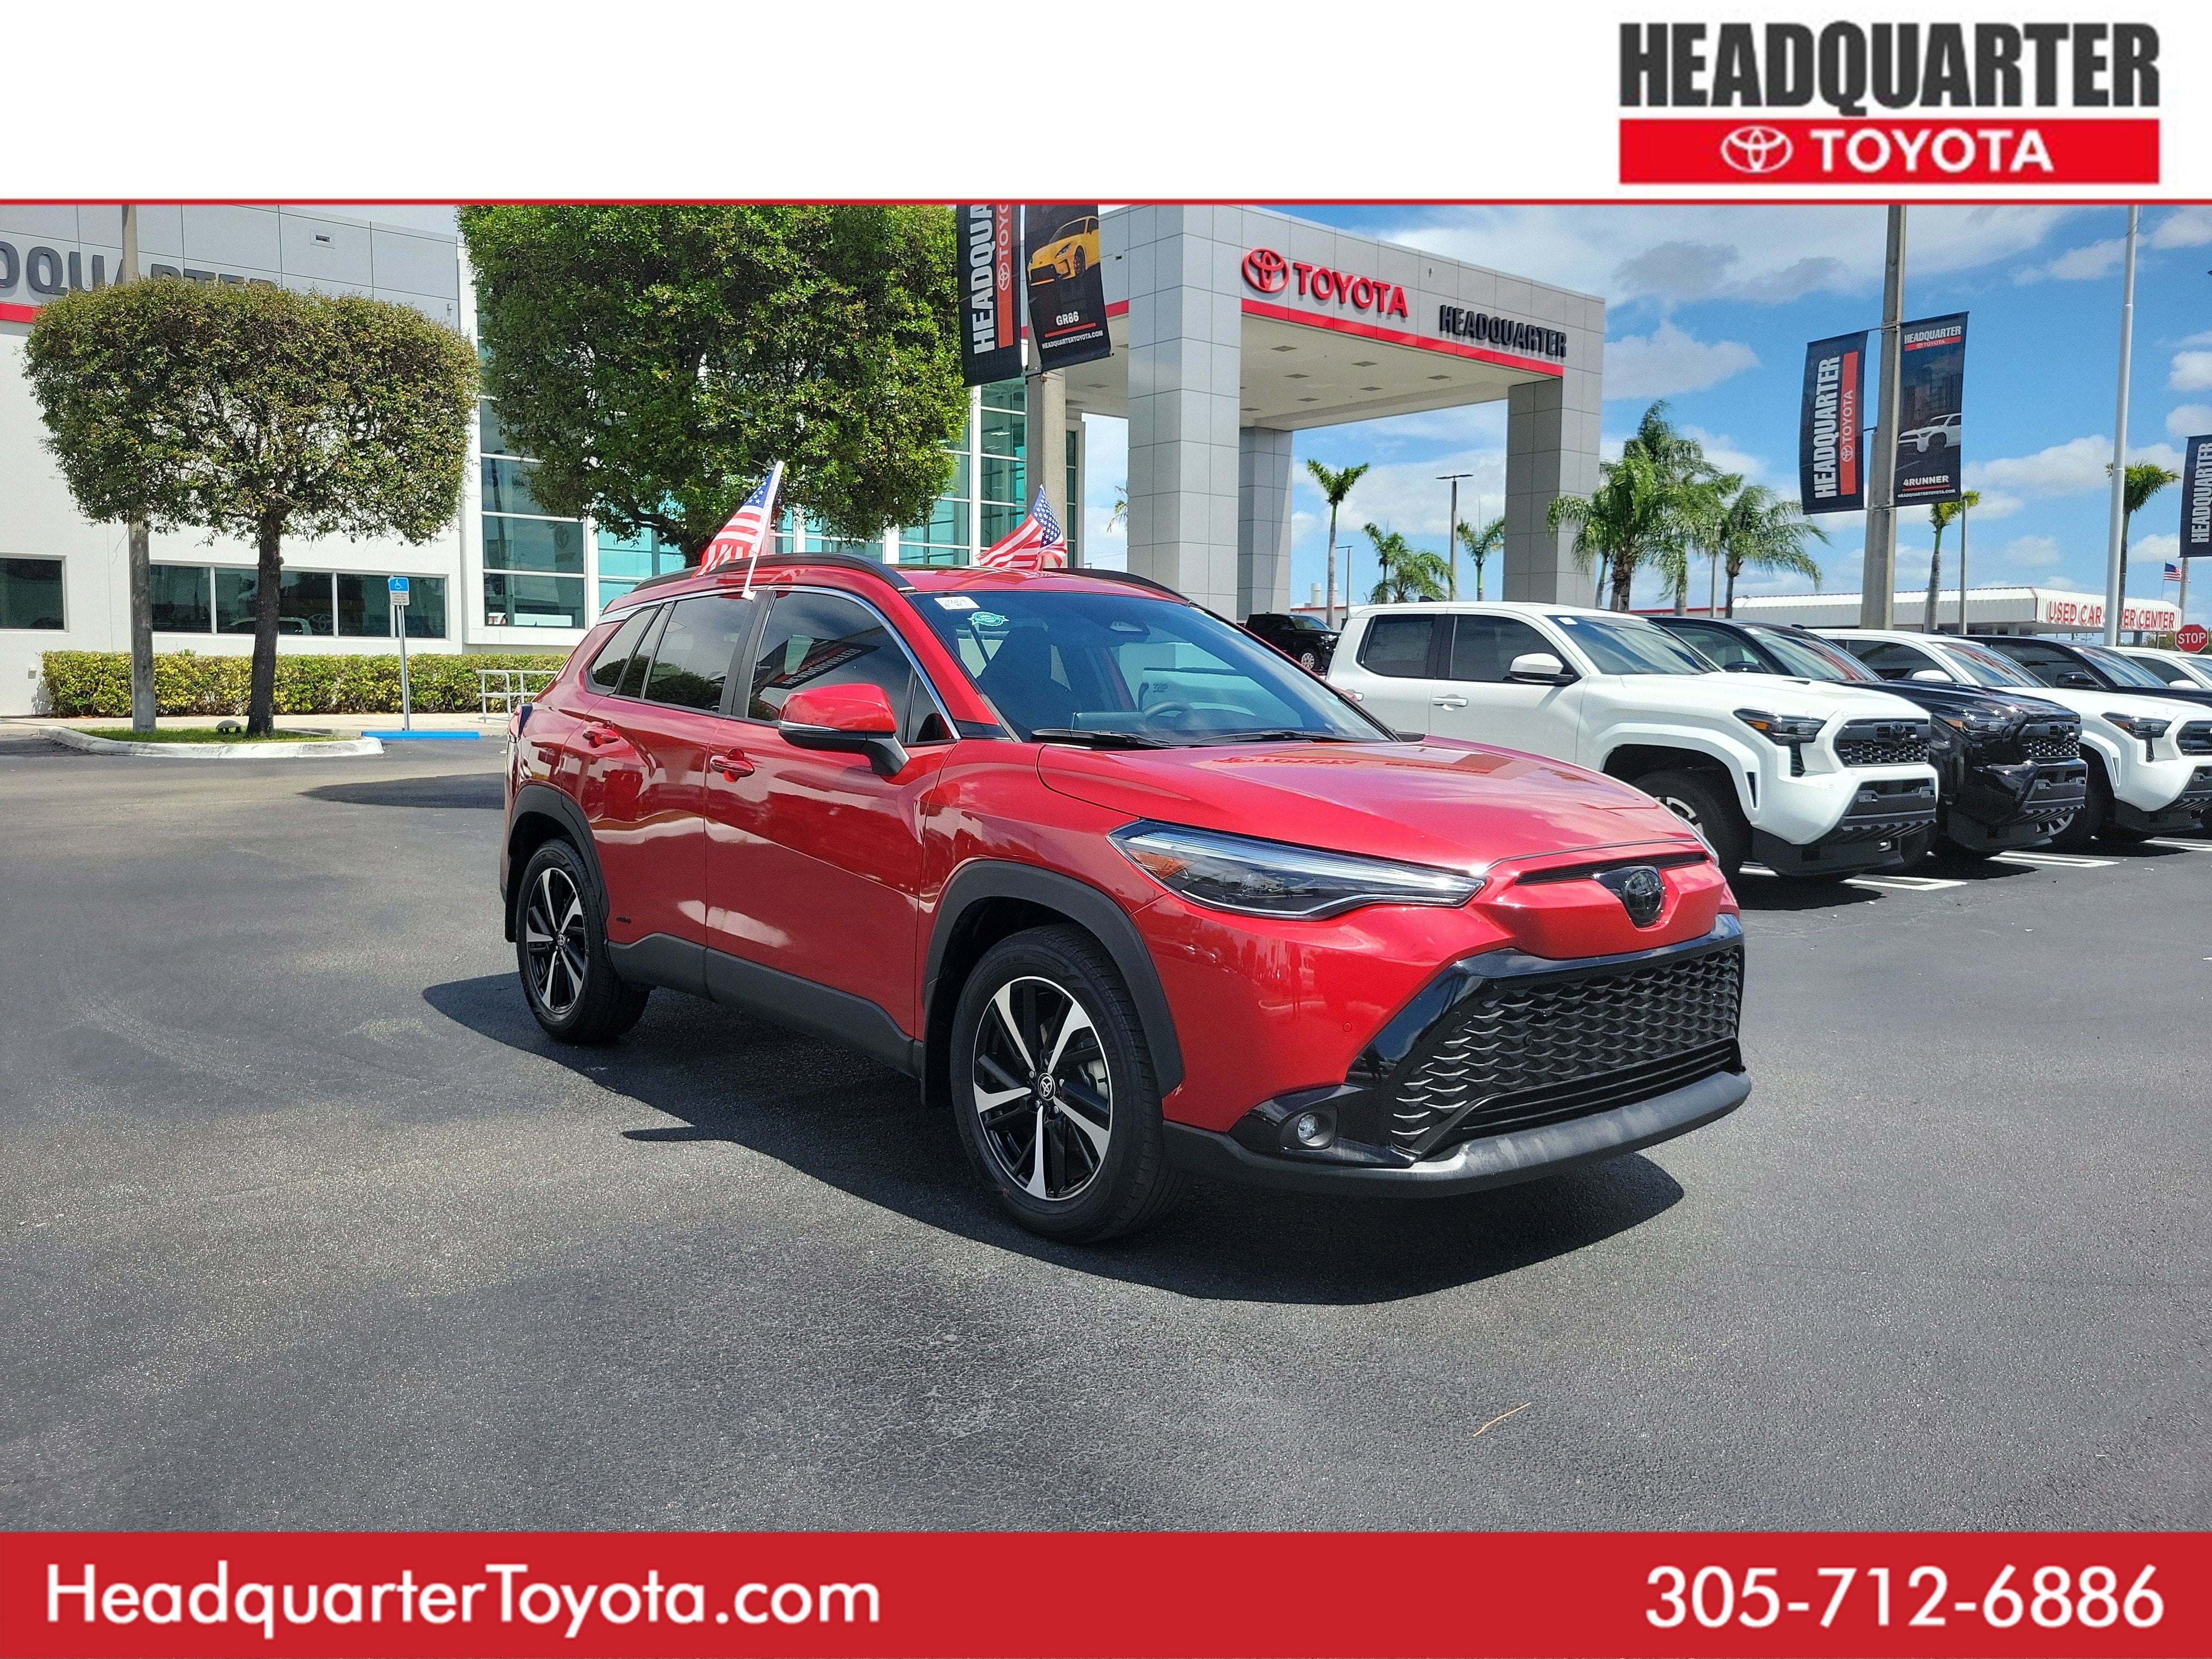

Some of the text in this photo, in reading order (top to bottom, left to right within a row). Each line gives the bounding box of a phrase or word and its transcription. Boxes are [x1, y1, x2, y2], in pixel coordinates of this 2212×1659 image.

[1293, 262, 1408, 318] TOYOTA
[1056, 311, 1079, 326] GR86
[1042, 330, 1103, 349] HEADQUARTERTOYOTA.COM
[1438, 304, 1567, 358] HEADQUARTER
[1904, 325, 1961, 345] HEADQUARTER
[1923, 340, 1945, 348] TOYOTA
[1813, 356, 1841, 499] HEADQUARTER
[1842, 390, 1853, 446] TOYOTA
[1903, 475, 1949, 487] 4RUNNER
[2191, 443, 2212, 543] HEADQUARTER
[2049, 601, 2076, 622] USED
[2080, 605, 2102, 624] CAR
[2139, 610, 2175, 629] CENTER
[2177, 633, 2206, 645] STOP
